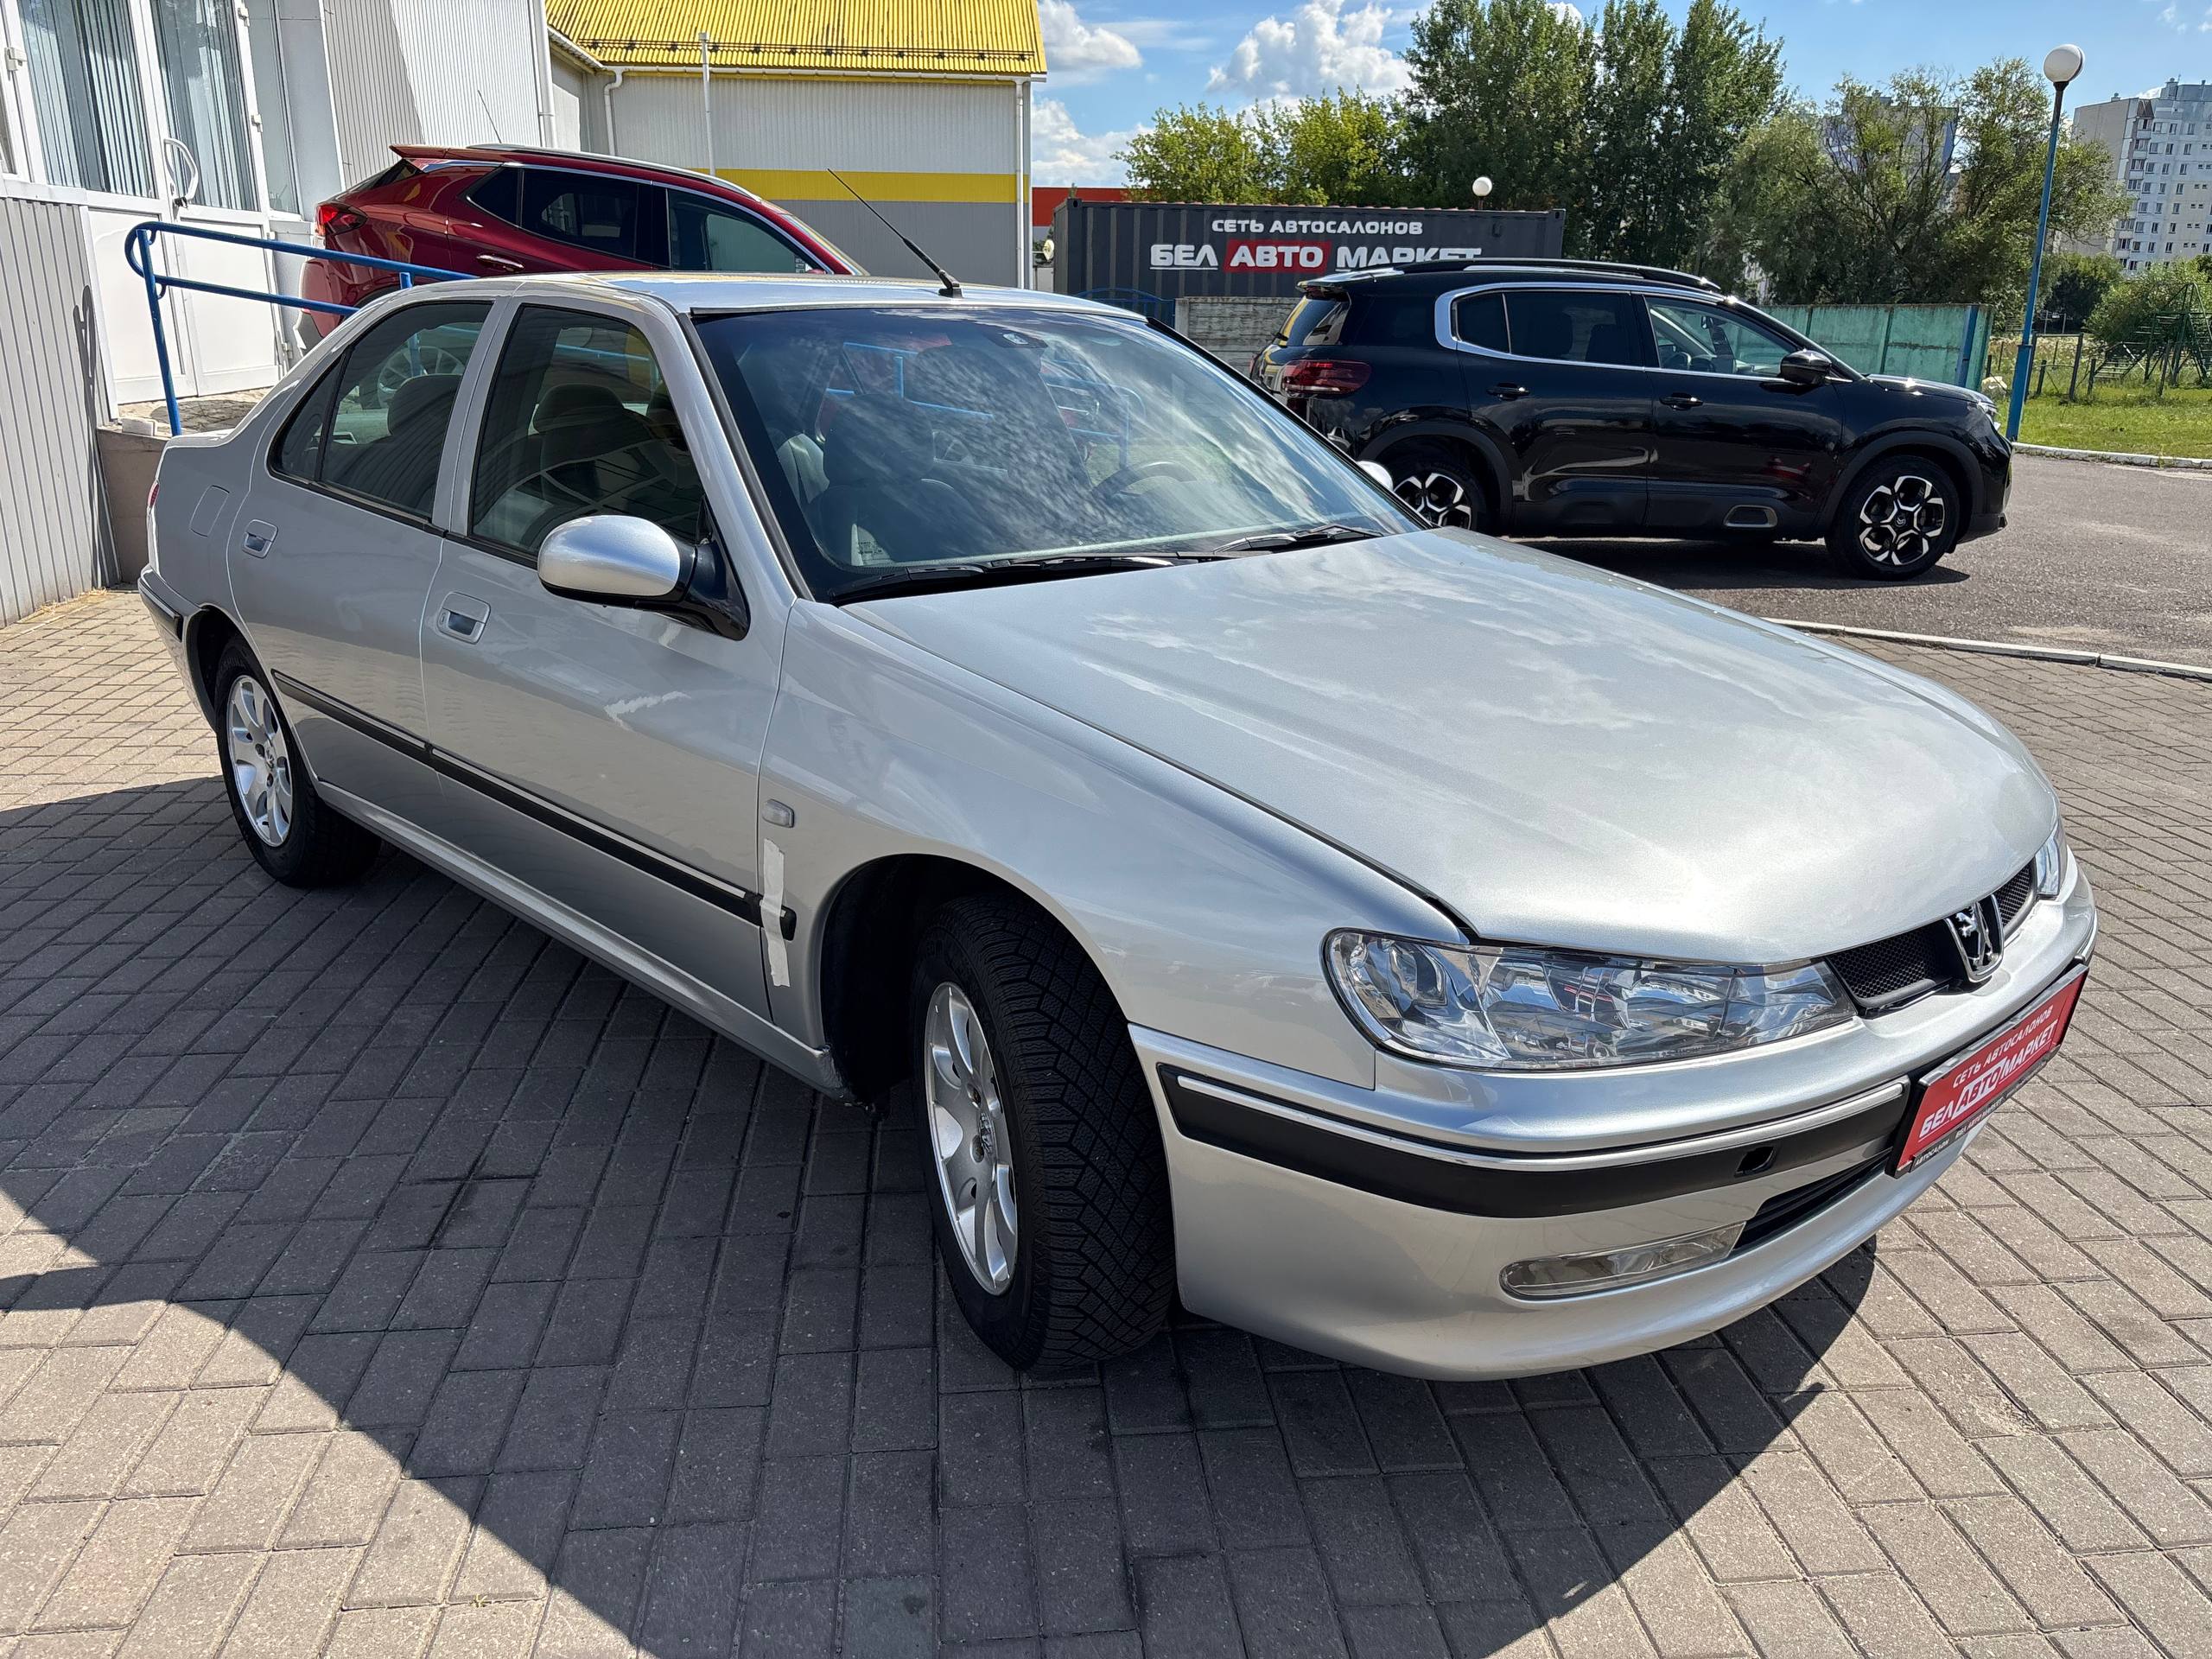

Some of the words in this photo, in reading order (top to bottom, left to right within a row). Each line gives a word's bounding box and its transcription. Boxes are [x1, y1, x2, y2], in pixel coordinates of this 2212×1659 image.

[1211, 219, 1264, 234] СЕТЬ
[1269, 220, 1424, 235] АВТОСАЛОНОВ
[1150, 244, 1218, 268] БЕЛ
[1230, 245, 1324, 268] АВТО
[1953, 1062, 1981, 1089] СЕТЬ
[1983, 1005, 2054, 1068] АВТОСАЛОНОВ
